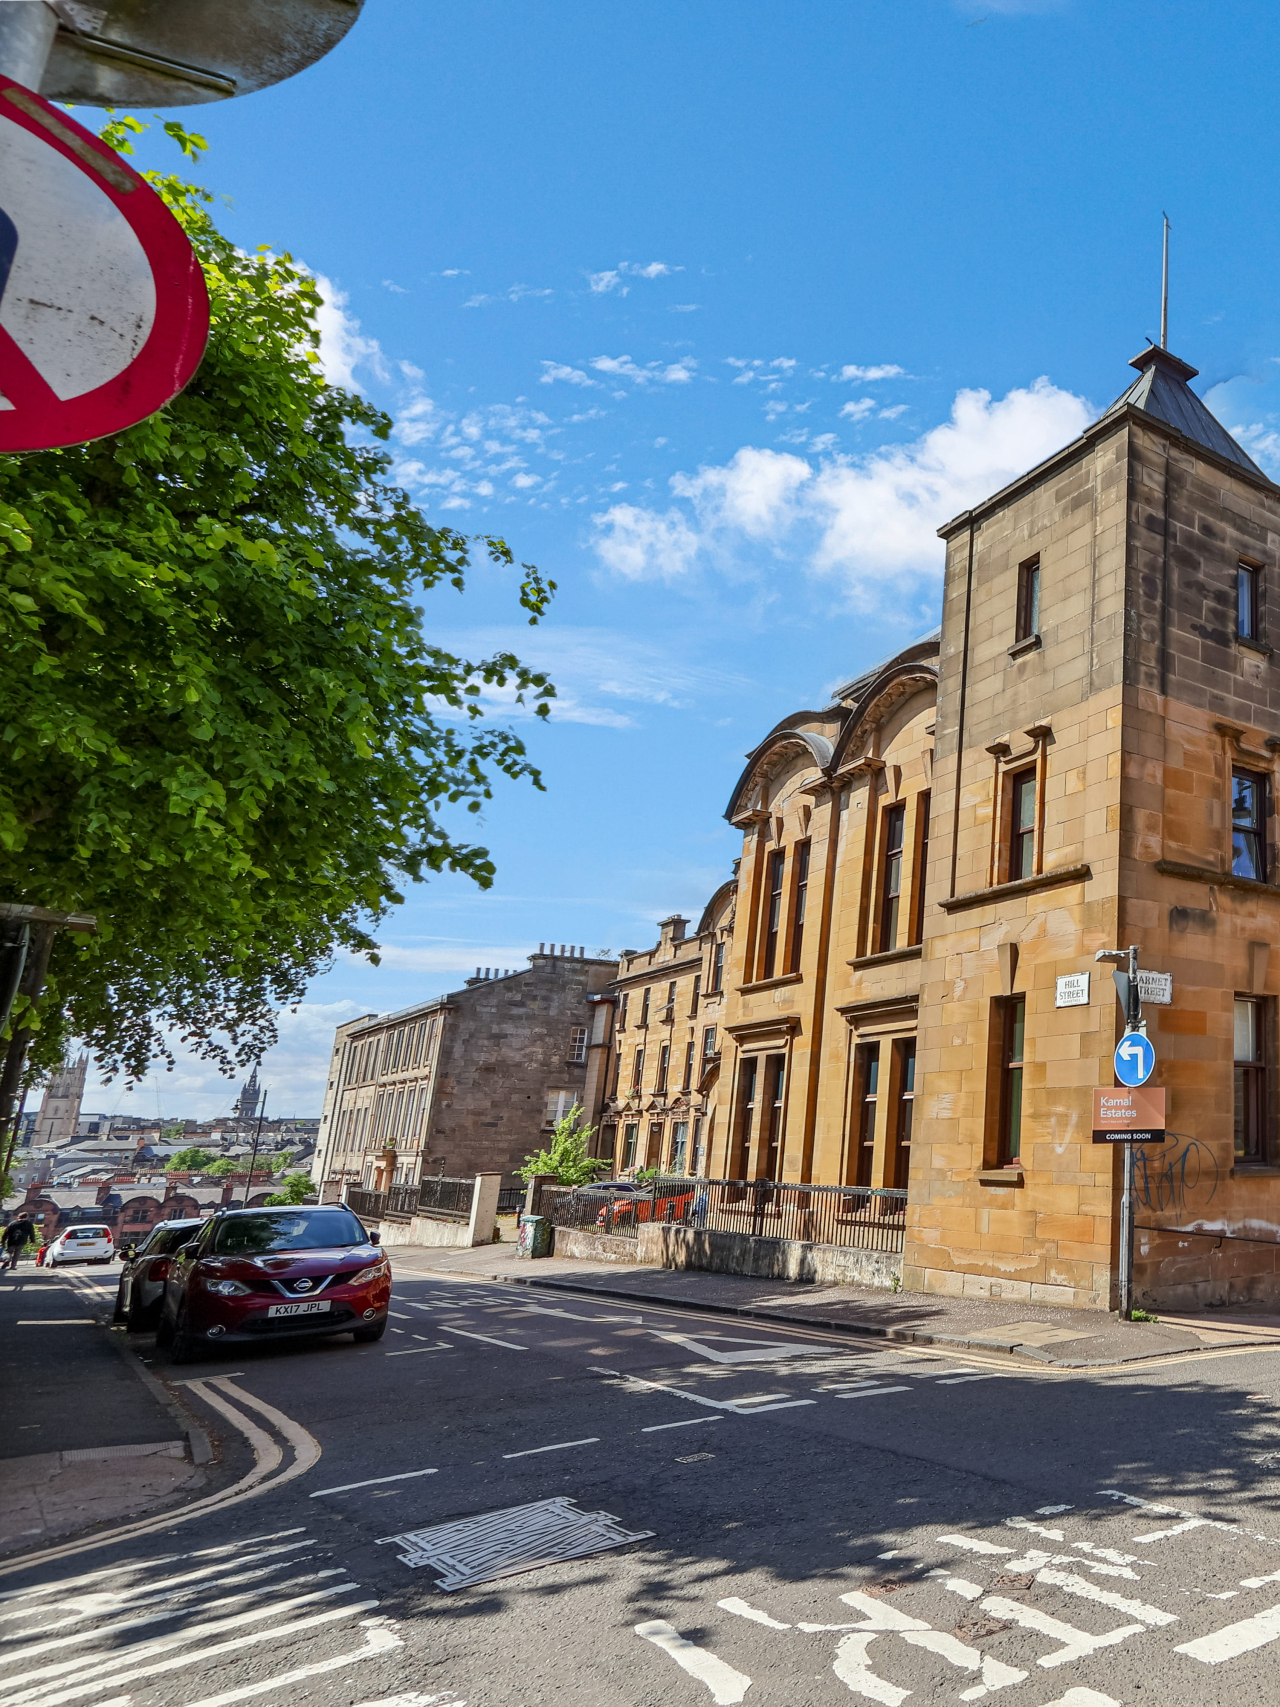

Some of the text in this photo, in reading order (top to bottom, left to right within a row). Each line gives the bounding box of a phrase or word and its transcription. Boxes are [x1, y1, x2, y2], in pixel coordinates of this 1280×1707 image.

[1064, 979, 1080, 989] HILL
[1138, 975, 1168, 986] ARNET
[1058, 988, 1085, 1000] STREET
[1139, 985, 1166, 997] TREET
[1100, 1096, 1132, 1106] Kamal
[1100, 1107, 1137, 1118] Estates
[275, 1303, 323, 1315] KX17 JPL
